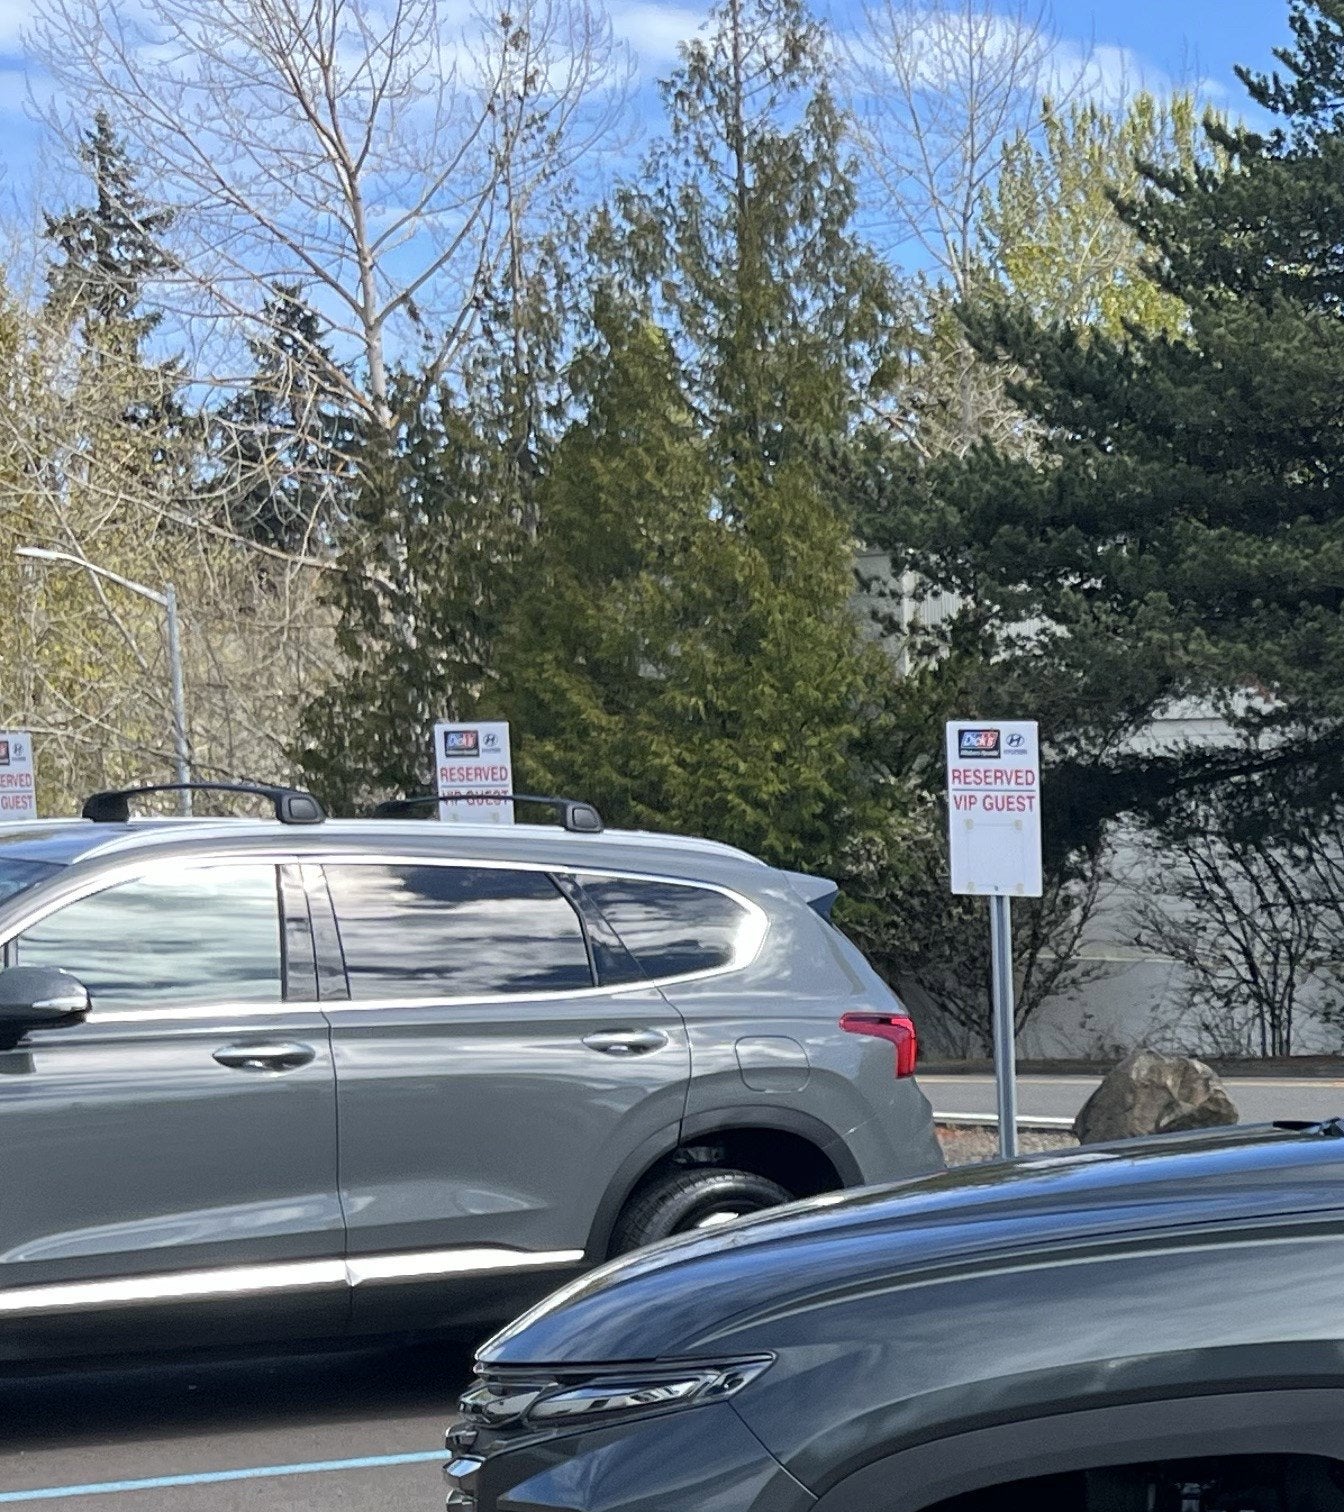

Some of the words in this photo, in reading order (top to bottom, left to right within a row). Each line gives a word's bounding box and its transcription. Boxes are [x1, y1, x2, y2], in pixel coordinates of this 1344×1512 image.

[440, 766, 508, 782] RESERVED
[952, 769, 1035, 785] RESERVED
[1, 796, 32, 810] GUEST
[954, 795, 977, 811] VIP
[983, 795, 1036, 812] GUEST
